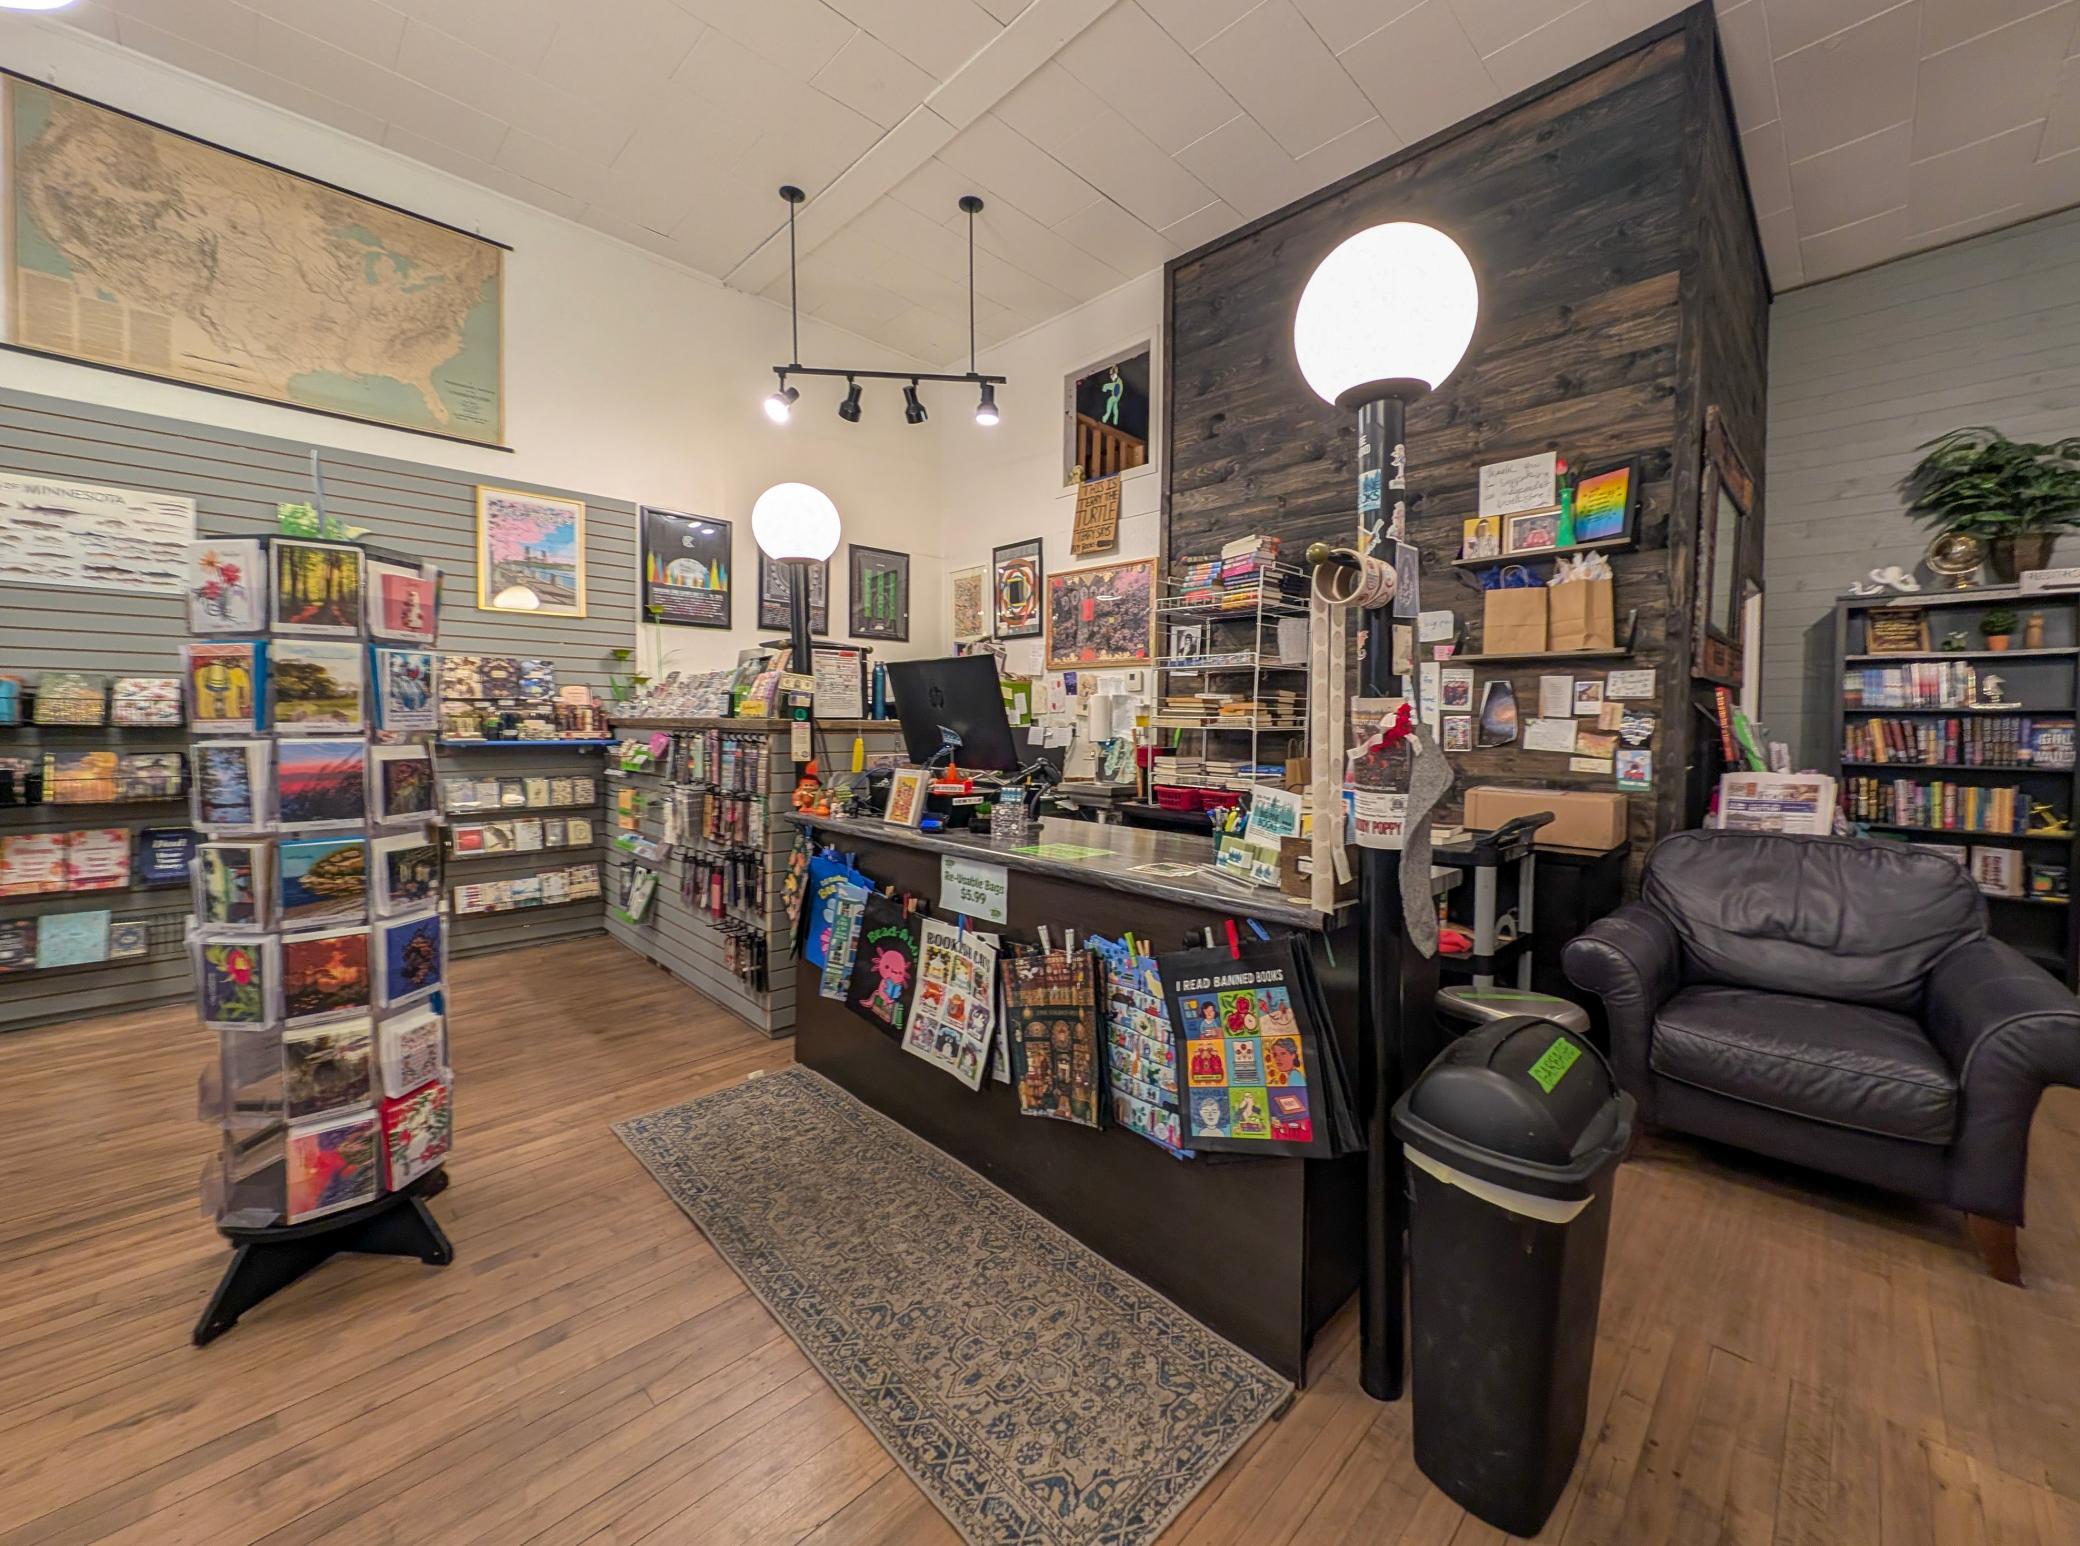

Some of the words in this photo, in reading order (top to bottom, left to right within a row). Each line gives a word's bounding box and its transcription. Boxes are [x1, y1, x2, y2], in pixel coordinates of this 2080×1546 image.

[23, 484, 126, 504] MINNESOTA
[1081, 483, 1105, 497] THIS
[1106, 481, 1118, 491] IS
[1075, 501, 1117, 529] TURTLE
[1372, 820, 1402, 835] POPPY
[960, 886, 987, 905] $5.99
[984, 879, 1004, 896] Bags
[1176, 980, 1181, 992] I
[1183, 977, 1211, 991] READ
[1213, 972, 1255, 988] BANNED
[1255, 968, 1284, 983] BOOKS
